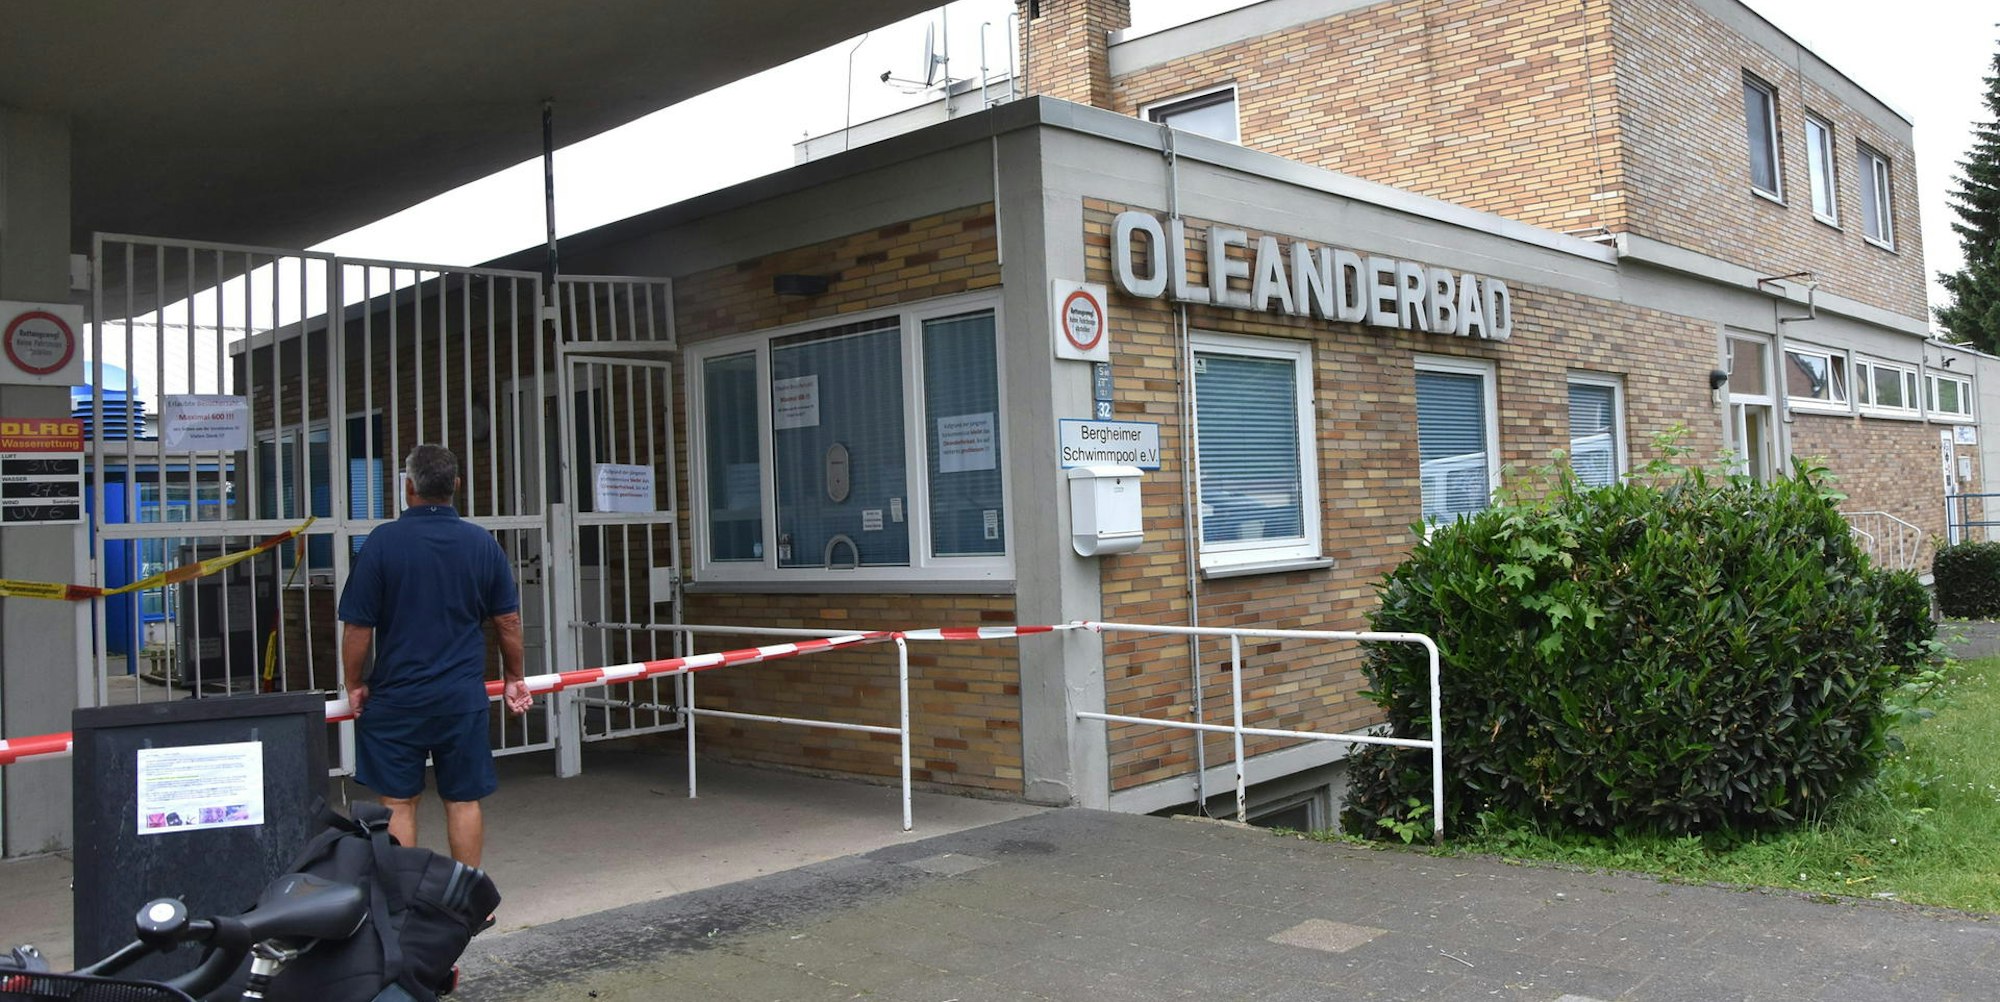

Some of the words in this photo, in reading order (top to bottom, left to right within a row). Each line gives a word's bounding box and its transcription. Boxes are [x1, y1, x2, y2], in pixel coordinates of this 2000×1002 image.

[1111, 211, 1512, 341] OLEANDERBAD
[178, 413, 210, 421] Maximal
[211, 412, 225, 421] 600
[1098, 402, 1111, 418] 32
[1, 422, 80, 436] DLRG
[1081, 425, 1142, 444] Bergheimer
[1, 438, 80, 450] Wasserrettung
[1063, 446, 1138, 465] Schwimmpool
[1140, 448, 1158, 463] e.V.
